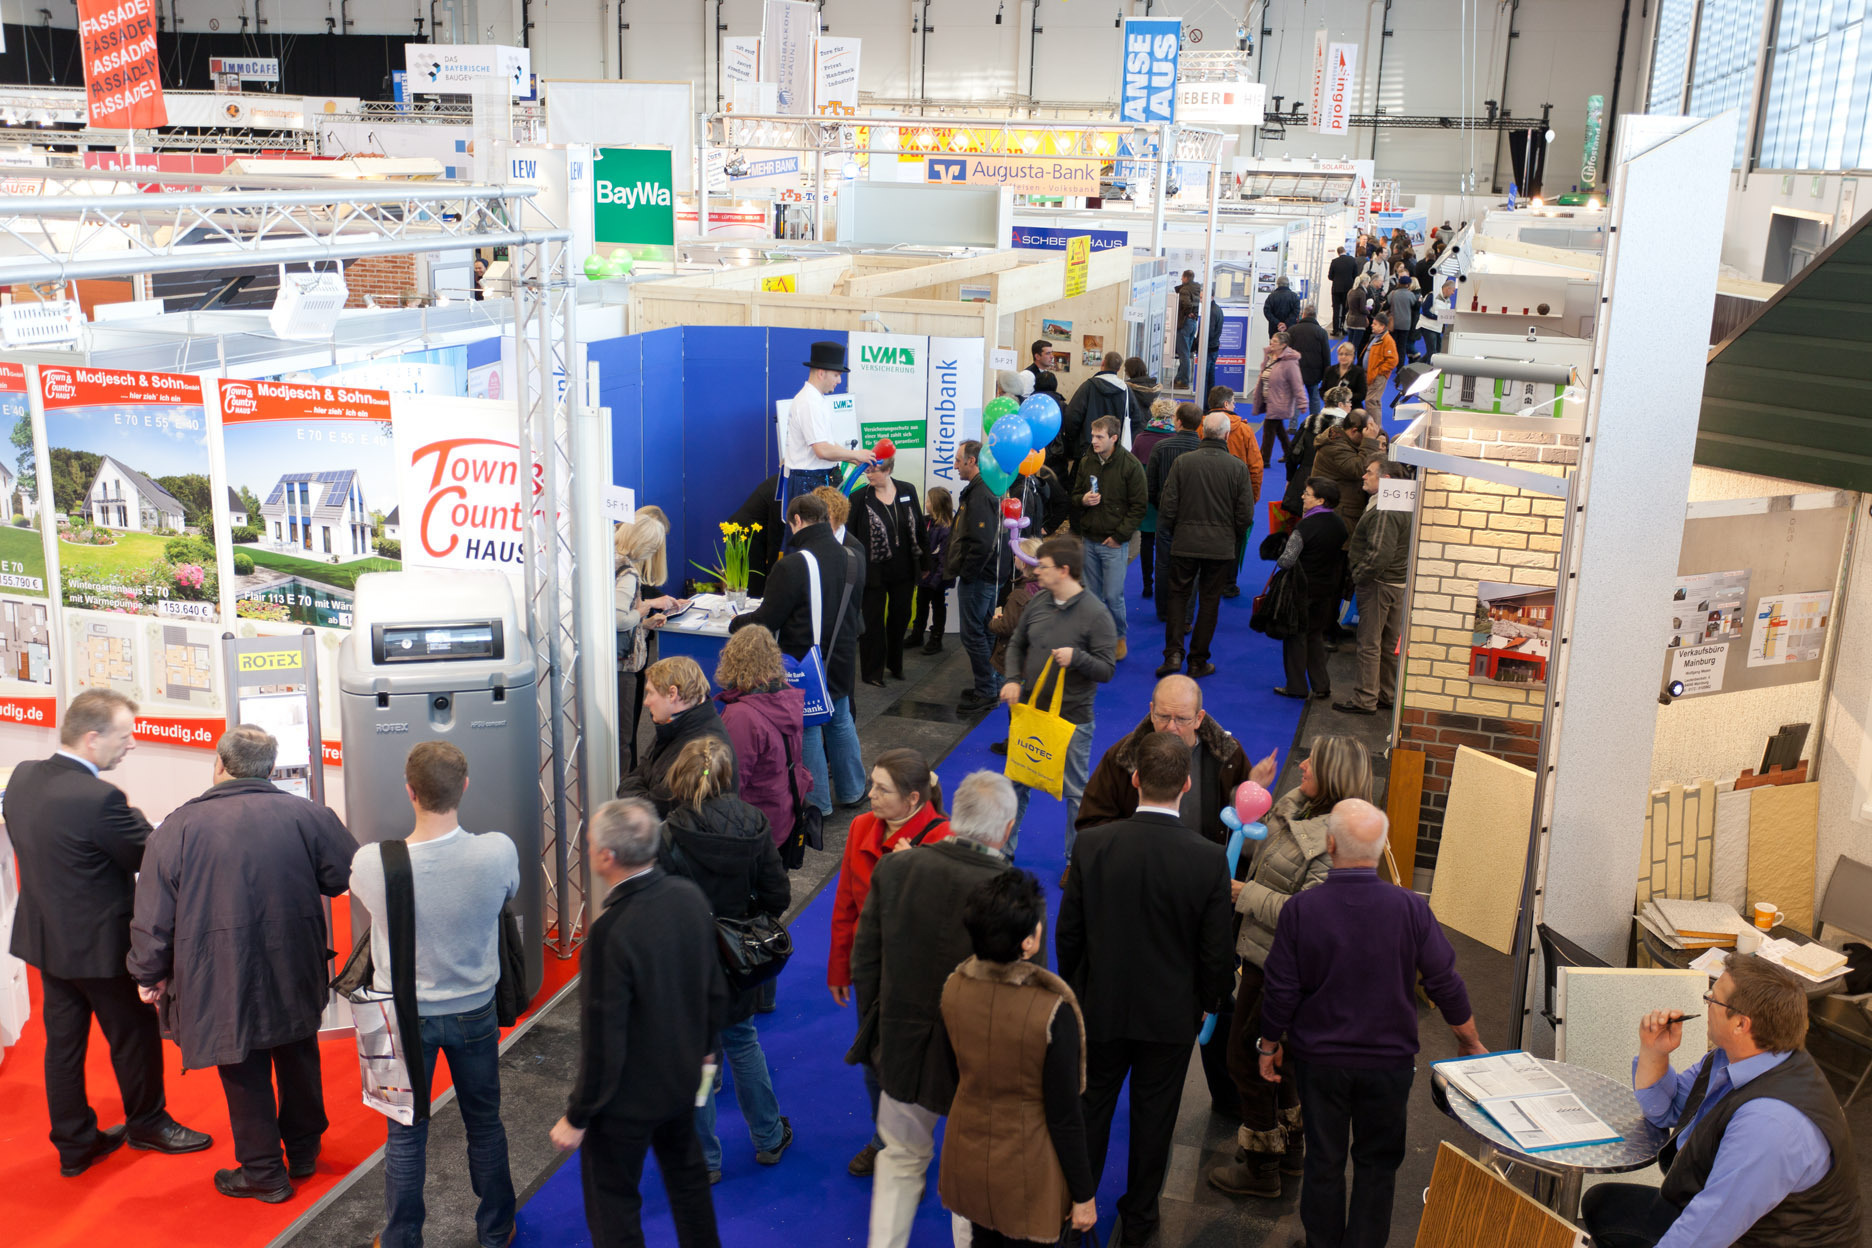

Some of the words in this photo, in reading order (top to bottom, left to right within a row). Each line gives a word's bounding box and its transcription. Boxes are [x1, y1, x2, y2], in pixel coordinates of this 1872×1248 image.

[1332, 78, 1348, 128] ingold
[512, 160, 536, 178] LEW
[570, 162, 583, 180] LEW
[751, 160, 774, 176] MEHR
[775, 157, 797, 174] BANK
[972, 161, 1094, 182] Augusta-Bank
[596, 180, 670, 209] BayWa
[780, 189, 829, 203] ITB-Toe
[861, 346, 897, 365] LVM
[42, 369, 66, 384] Town
[861, 364, 915, 374] VERSICHERUNG
[76, 370, 137, 387] Modjesch
[140, 374, 149, 386] &
[152, 376, 184, 389] Sohn
[45, 380, 76, 399] Country
[222, 383, 247, 398] Town
[247, 388, 253, 398] &
[258, 384, 321, 400] Modjesch
[324, 389, 334, 400] &
[338, 390, 372, 404] Sohn
[2, 404, 10, 415] E
[12, 405, 24, 416] 40
[224, 396, 257, 413] Country
[834, 400, 846, 409] LVM
[114, 414, 122, 424] E
[125, 414, 138, 426] 70
[144, 416, 152, 426] E
[156, 417, 168, 428] 55
[175, 419, 182, 429] E
[184, 419, 198, 430] 40
[934, 360, 958, 480] Aktienbank
[297, 429, 304, 439] E
[308, 430, 322, 440] 70
[329, 432, 336, 442] E
[341, 432, 354, 443] 55
[361, 434, 368, 444] E
[412, 438, 520, 493] Town
[1383, 489, 1401, 500] 5-G
[1404, 491, 1416, 500] 15
[606, 499, 618, 510] 5-F
[620, 502, 628, 512] 11
[465, 538, 524, 564] HAUS
[2, 561, 9, 571] E
[11, 562, 23, 573] 70
[33, 580, 38, 589] €
[68, 578, 143, 595] Wintergartenhaus
[146, 586, 153, 596] E
[156, 587, 169, 598] 70
[70, 594, 82, 603] mit
[86, 596, 143, 611] Wärmepumpe
[245, 592, 266, 602] Flair
[268, 594, 284, 603] 113
[287, 594, 295, 605] E
[298, 595, 312, 607] 70
[315, 600, 329, 609] mit
[164, 603, 200, 616] 153.640
[202, 607, 208, 616] €
[1679, 646, 1724, 657] Verkaufsbüro
[243, 653, 299, 669] ROTEX
[1684, 658, 1716, 668] Mainburg
[132, 721, 212, 742] ufreudig.de
[376, 723, 408, 733] ROTEX
[1017, 739, 1052, 760] ILIOTEC
